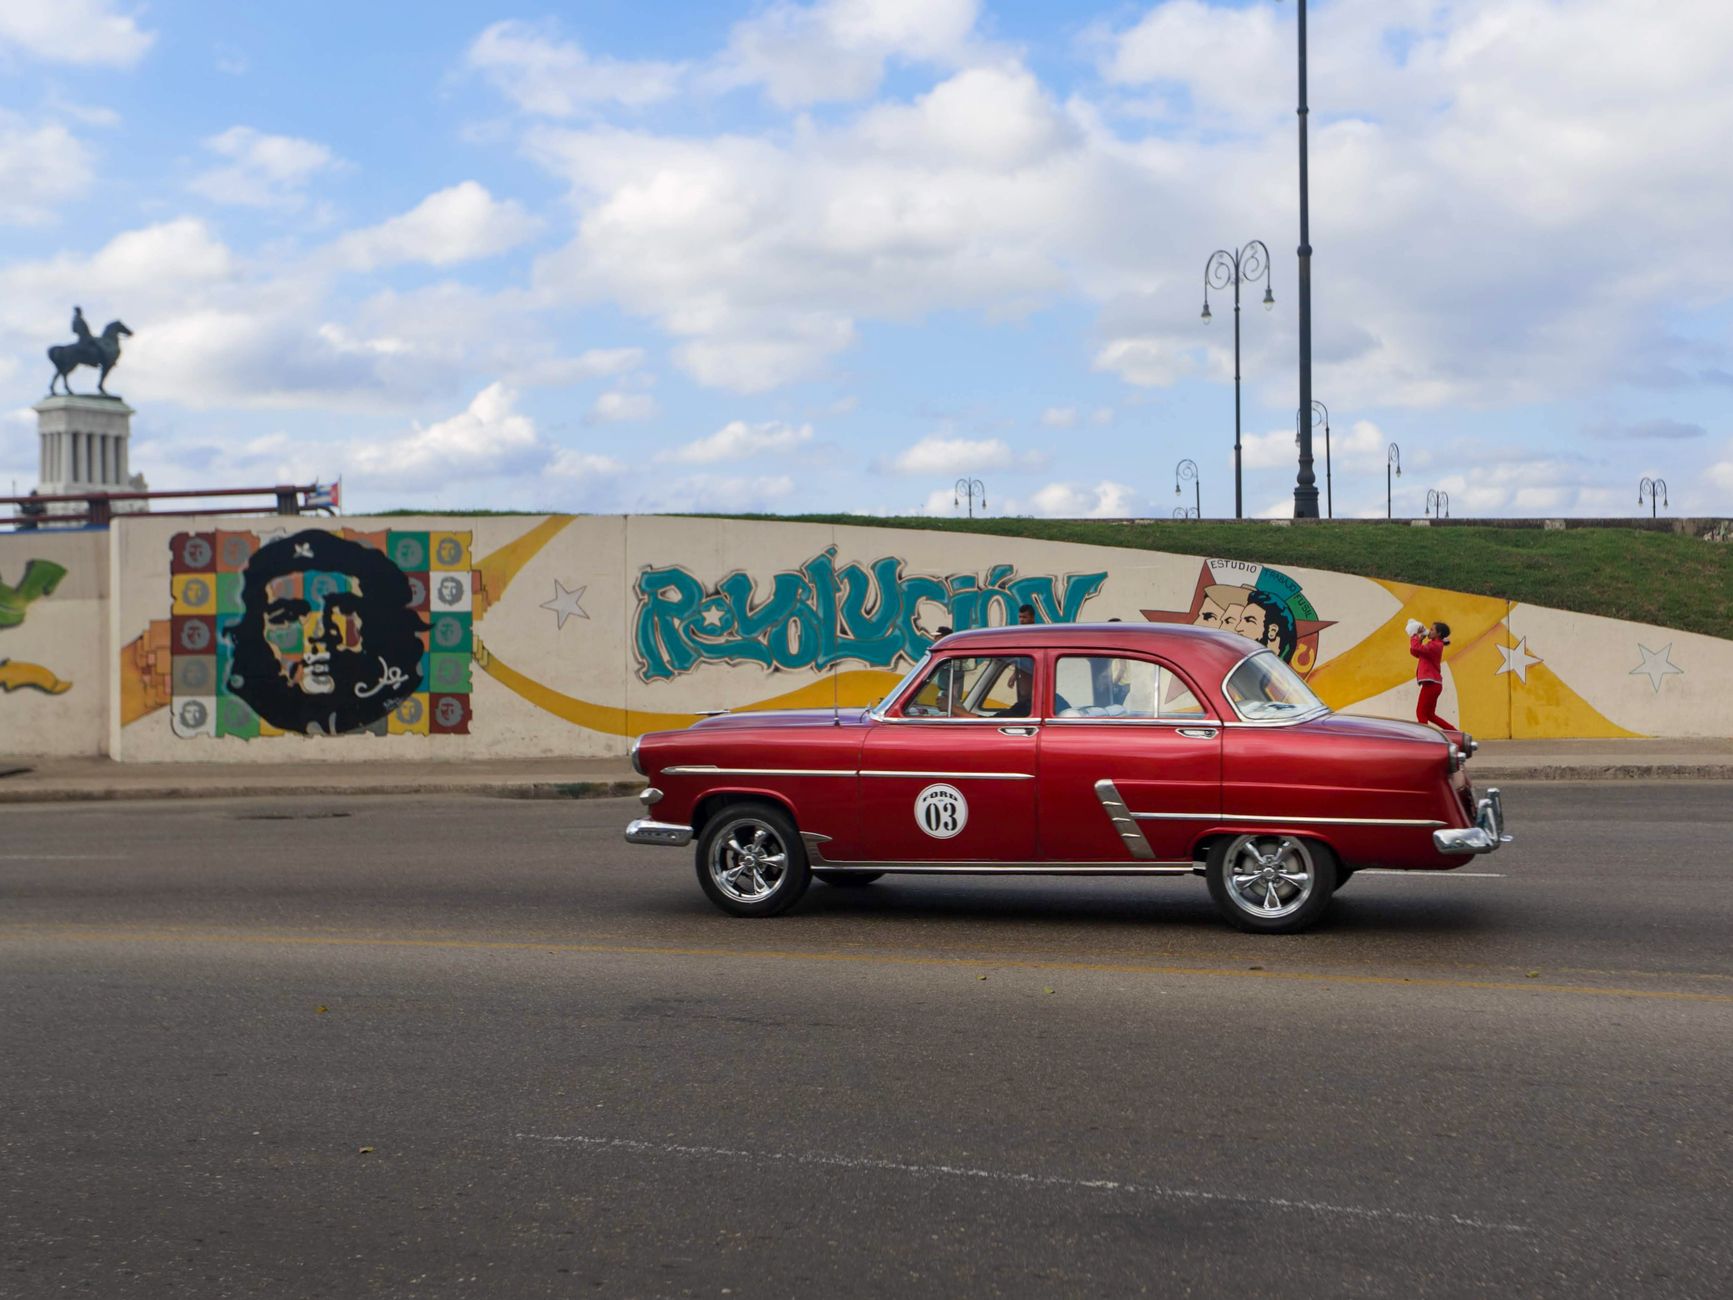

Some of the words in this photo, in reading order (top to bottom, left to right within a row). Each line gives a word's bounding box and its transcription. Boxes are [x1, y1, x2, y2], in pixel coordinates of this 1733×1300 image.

[1210, 560, 1257, 574] ESTUDIO
[1294, 594, 1312, 618] FUSIL
[925, 803, 957, 831] 03
